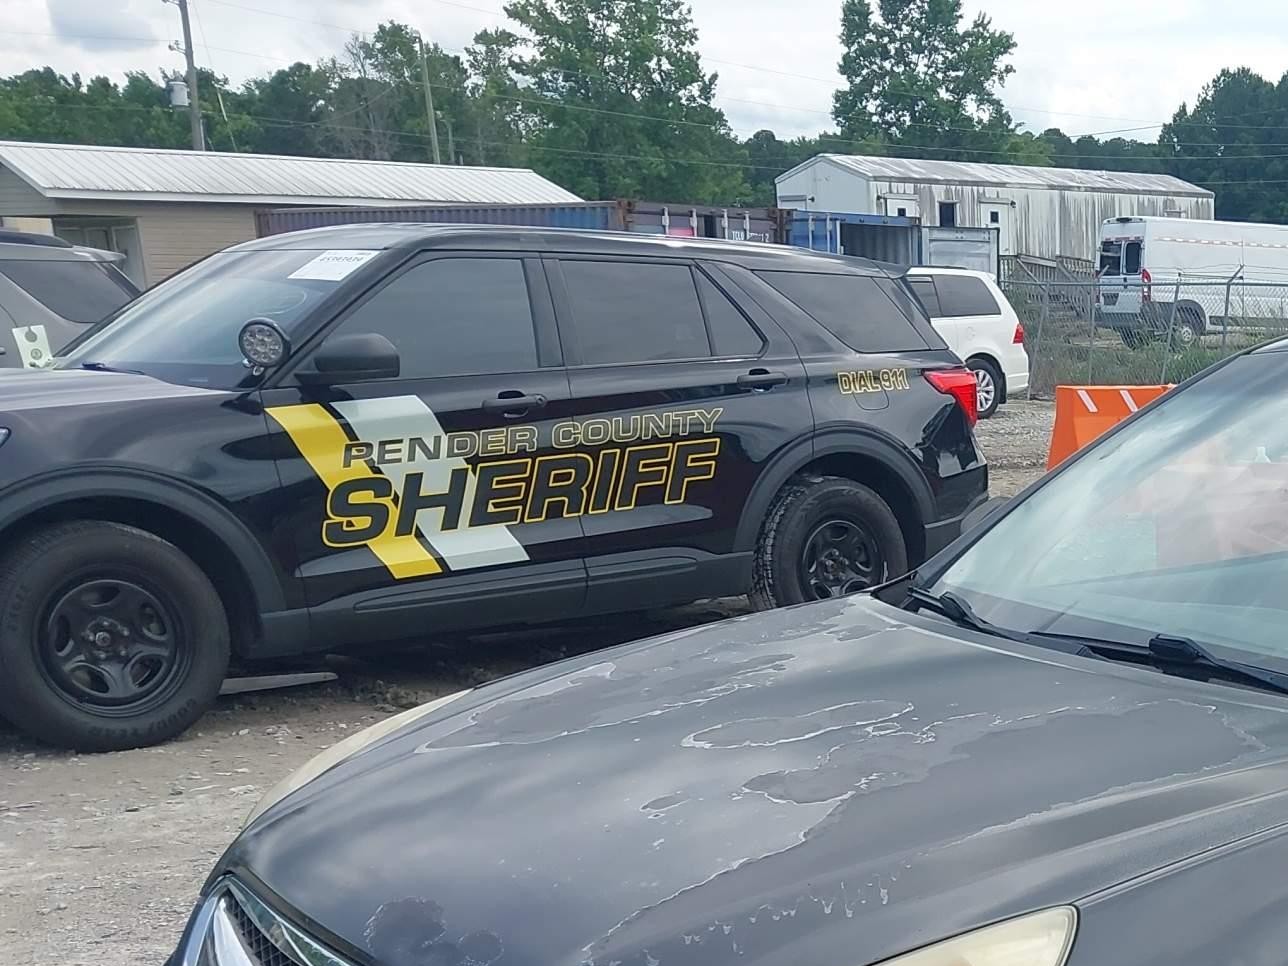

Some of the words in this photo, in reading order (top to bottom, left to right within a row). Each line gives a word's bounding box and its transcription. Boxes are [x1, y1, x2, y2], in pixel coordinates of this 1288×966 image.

[838, 371, 881, 395] DIAL
[880, 368, 910, 391] 911
[342, 427, 537, 467] PENDER
[552, 407, 723, 447] COUNTY
[322, 438, 721, 548] SHERIFF
